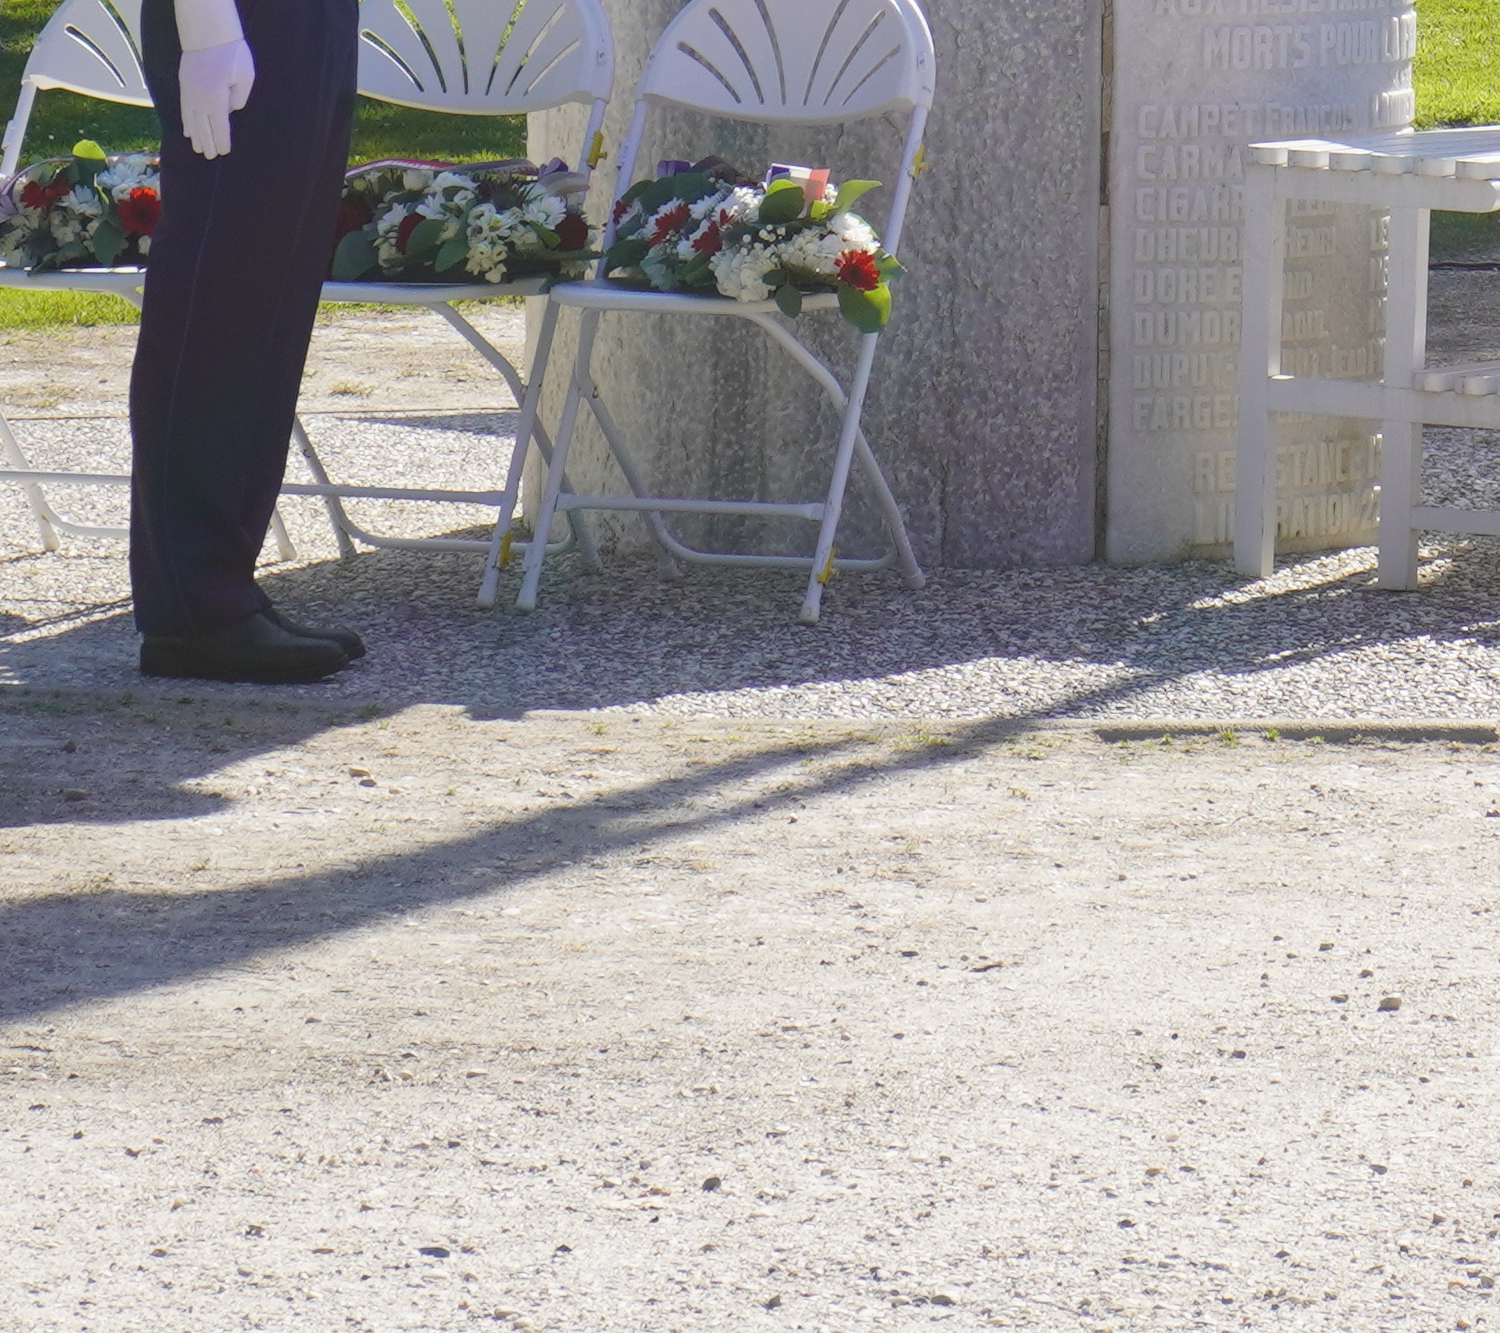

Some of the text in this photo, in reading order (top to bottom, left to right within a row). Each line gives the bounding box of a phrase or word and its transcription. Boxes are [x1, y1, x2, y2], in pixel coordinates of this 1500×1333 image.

[1202, 24, 1311, 71] MORTS
[1319, 19, 1377, 67] POUR
[1132, 393, 1239, 430] FARGE
